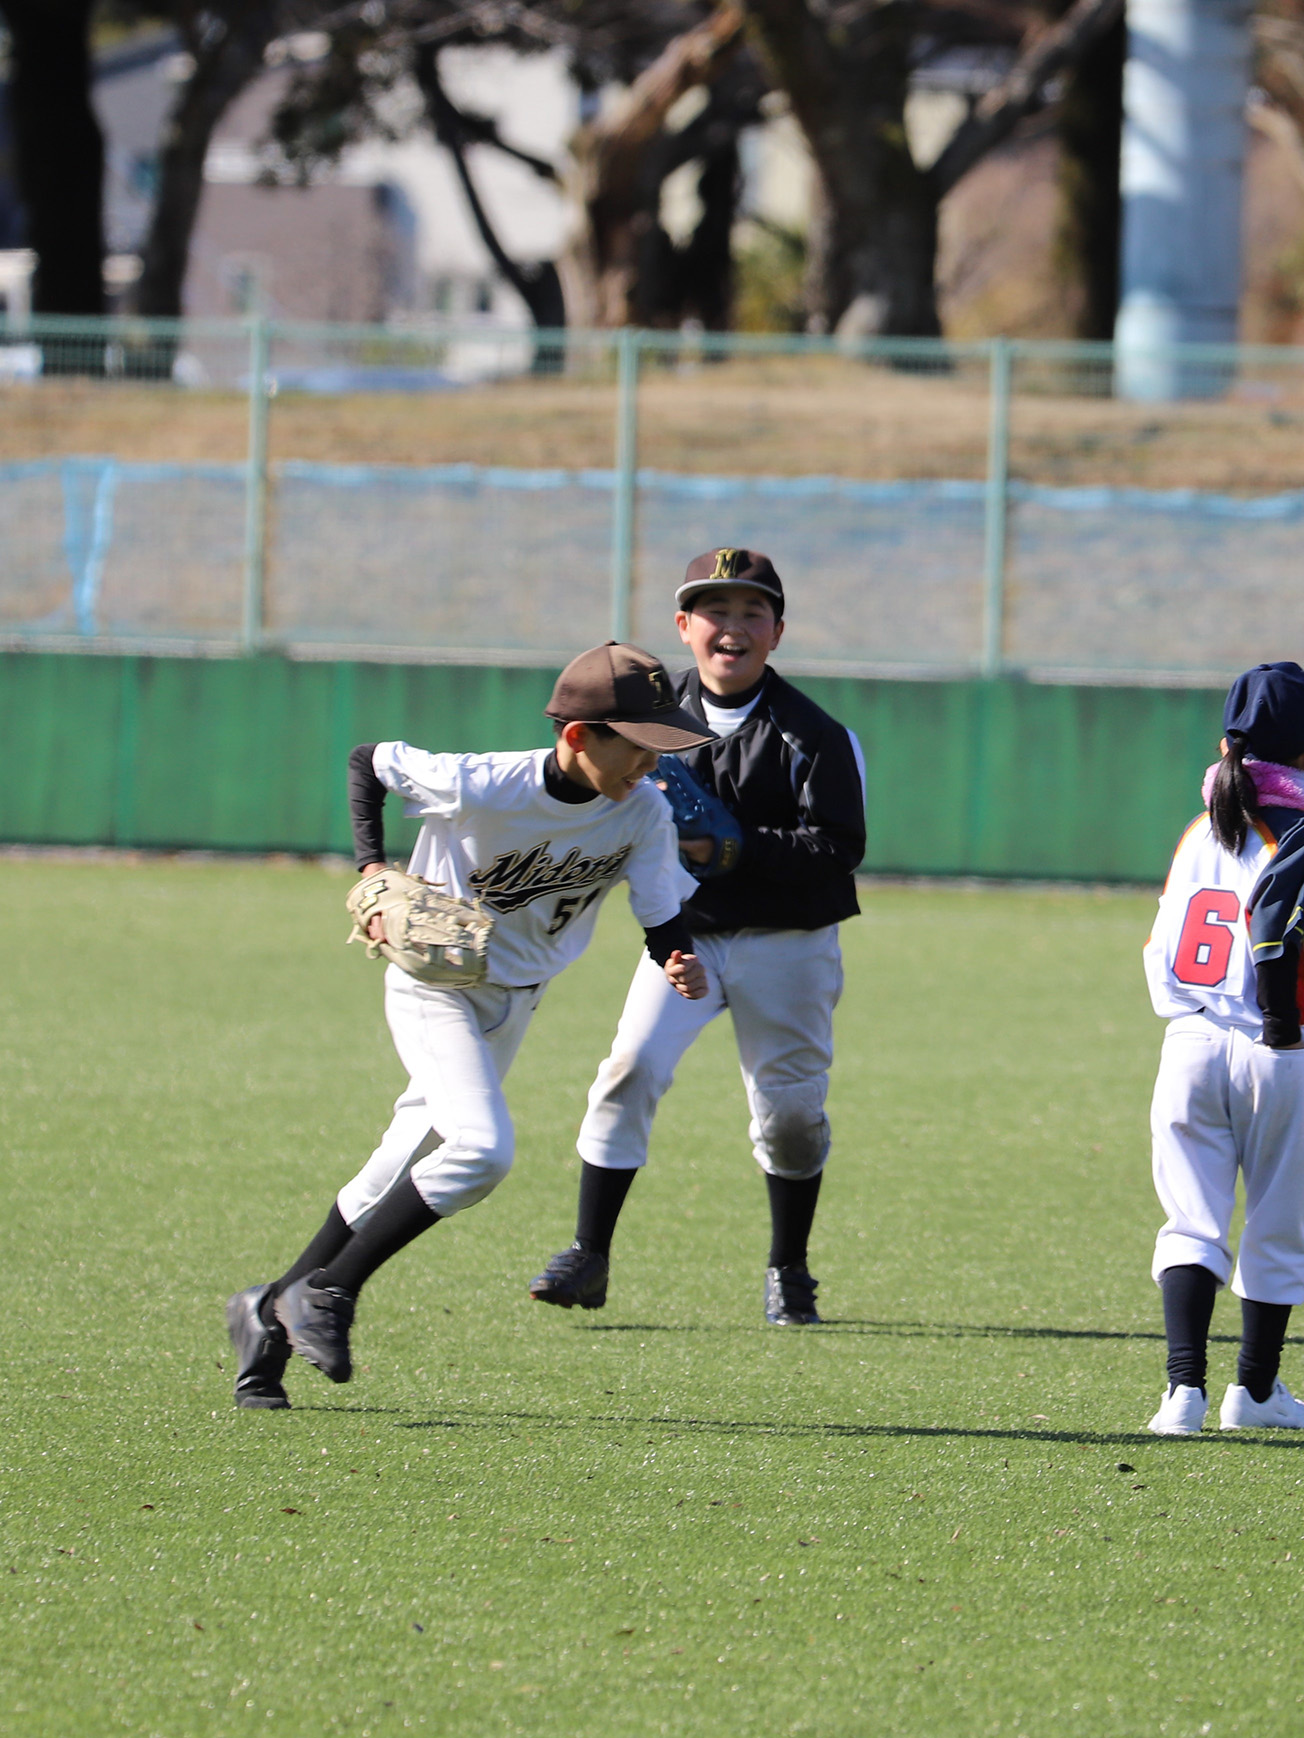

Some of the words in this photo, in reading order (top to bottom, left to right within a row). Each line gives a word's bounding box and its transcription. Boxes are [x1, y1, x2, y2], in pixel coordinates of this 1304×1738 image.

[709, 548, 741, 579] M
[467, 840, 633, 893] Midori
[1172, 887, 1241, 988] 6
